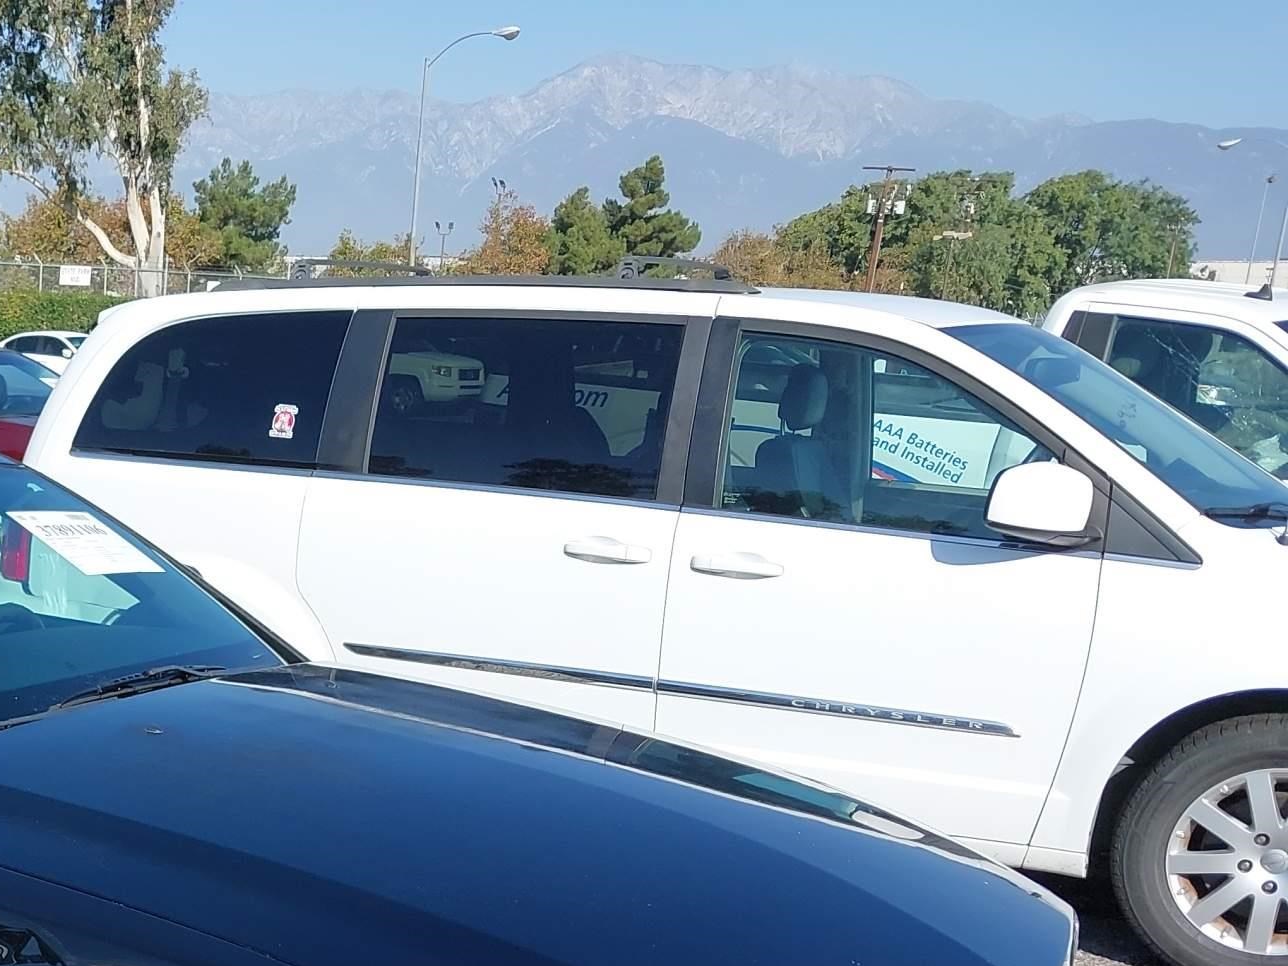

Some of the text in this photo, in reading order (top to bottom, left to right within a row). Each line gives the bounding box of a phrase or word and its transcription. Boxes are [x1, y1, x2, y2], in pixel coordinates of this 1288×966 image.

[873, 419, 969, 471] AAA Batteries
[873, 436, 963, 484] and Installed
[35, 524, 108, 537] 37891106
[791, 699, 985, 729] CHRYSLER
